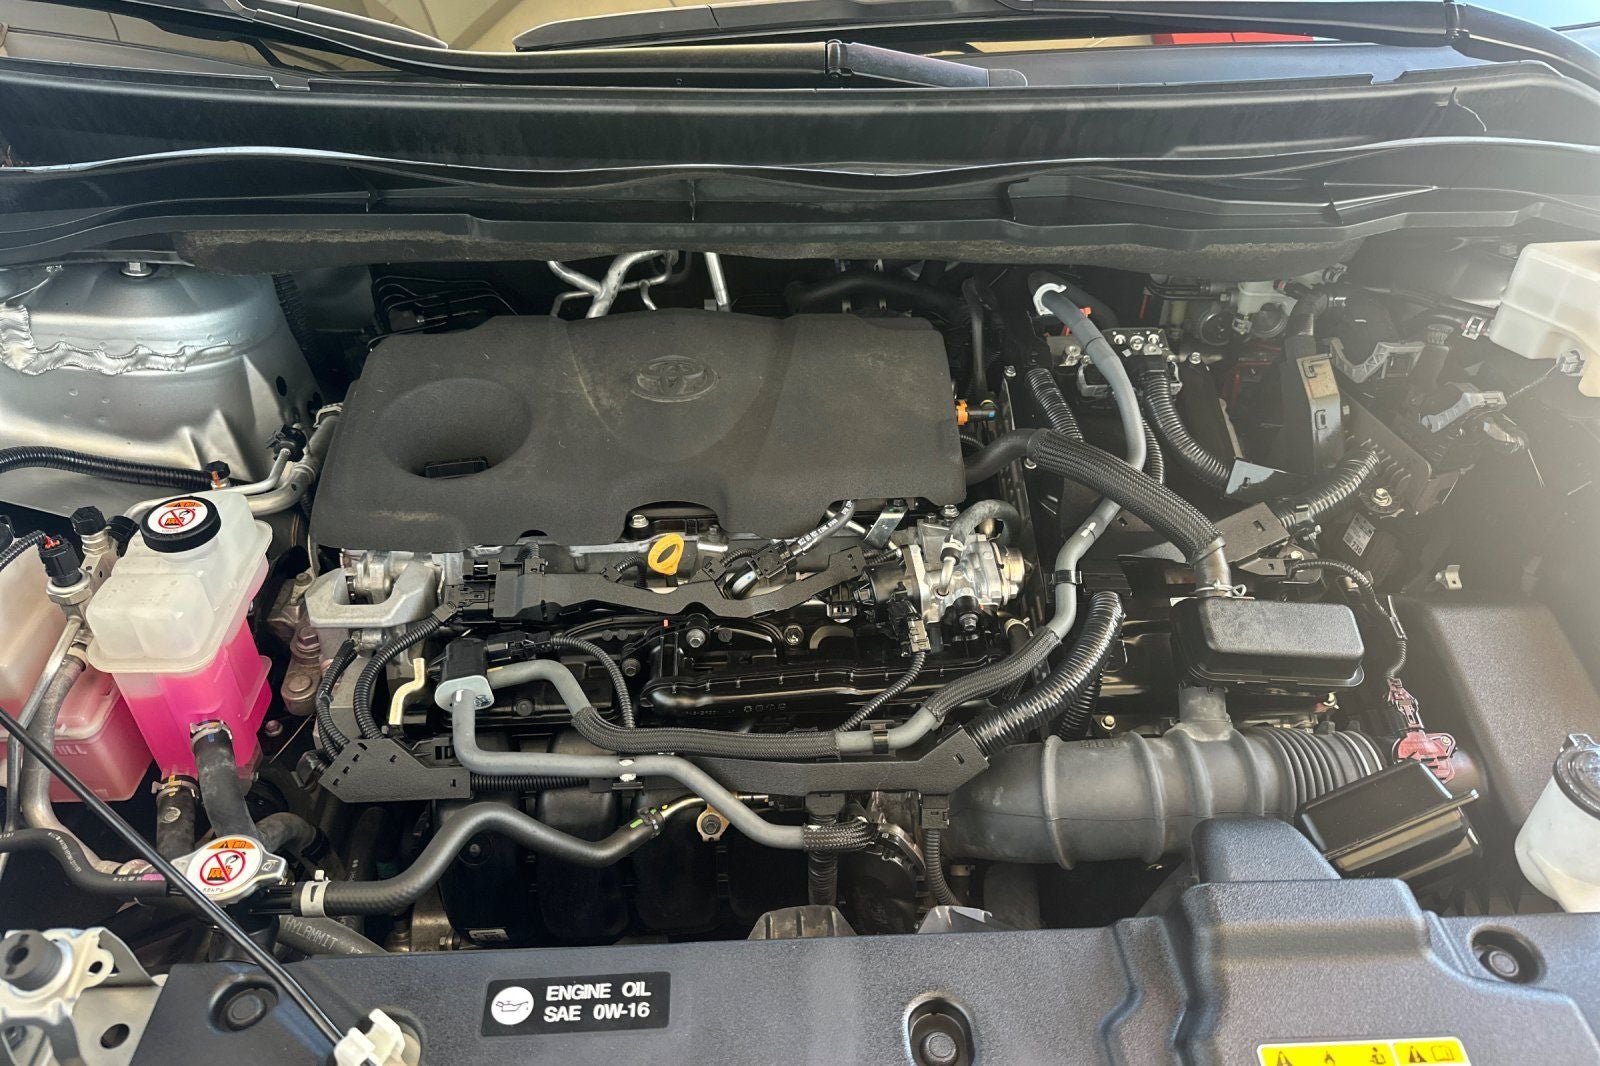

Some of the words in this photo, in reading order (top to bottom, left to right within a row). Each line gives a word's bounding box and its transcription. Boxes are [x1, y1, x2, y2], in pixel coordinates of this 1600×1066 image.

[52, 744, 87, 755] ULL
[546, 983, 612, 1001] ENGINE
[622, 981, 652, 998] OIL
[543, 1005, 582, 1023] SAE
[593, 1002, 651, 1019] 0W-16
